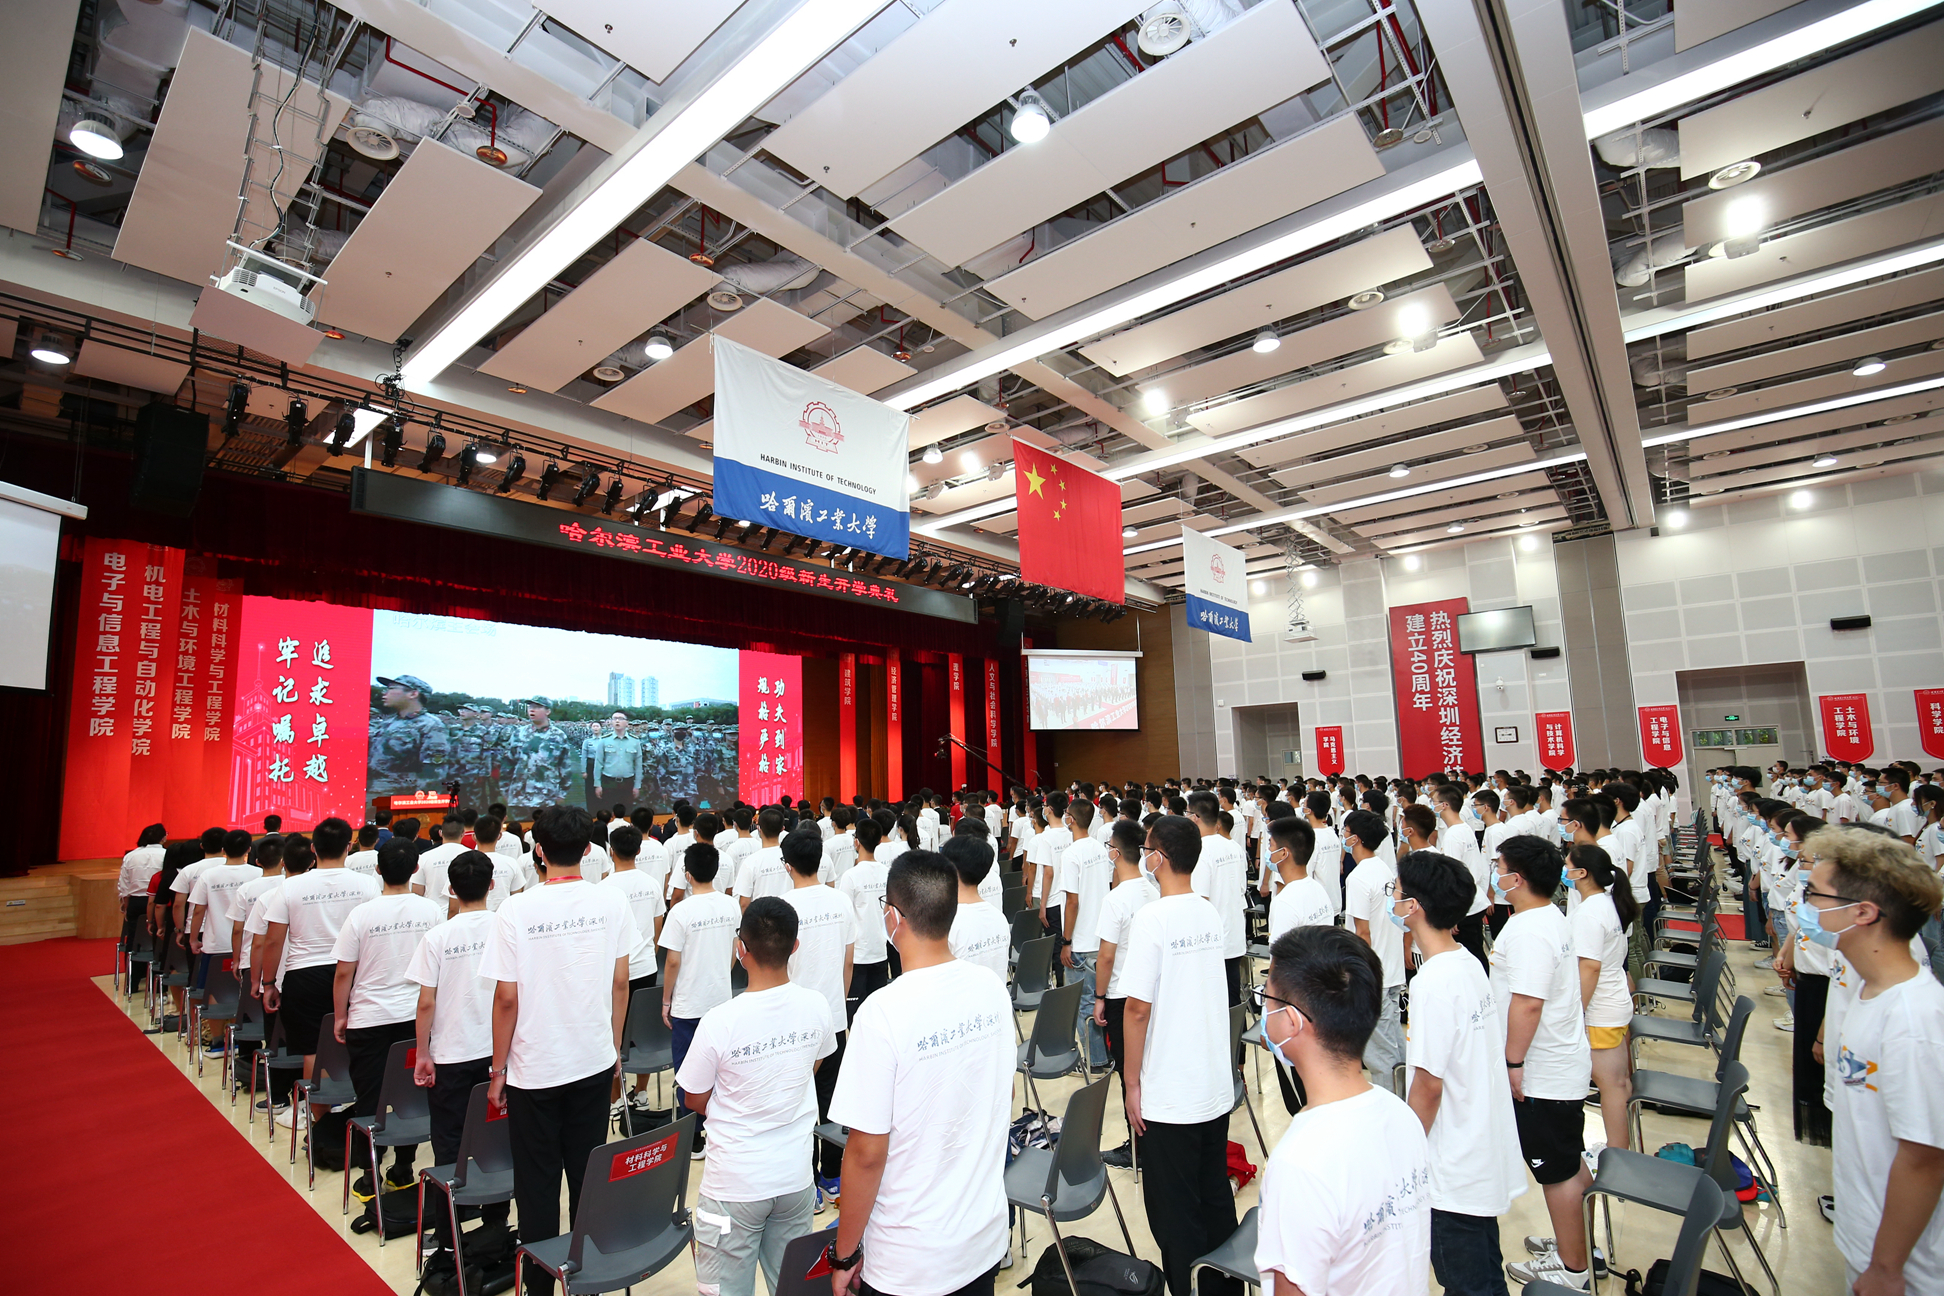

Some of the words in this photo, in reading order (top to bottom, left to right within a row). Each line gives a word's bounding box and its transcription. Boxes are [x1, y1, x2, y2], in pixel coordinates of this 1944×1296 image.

[760, 453, 787, 468] HARBIN
[790, 462, 823, 479] INSTITUTE
[826, 473, 834, 482] OF
[837, 477, 877, 495] TECHNOLOGY
[559, 521, 900, 603] 哈尔滨工业大学2020级新生开学典礼
[89, 552, 126, 737] 电子与信息工程学院
[131, 564, 166, 756] 机电工程与自动化学院
[171, 588, 201, 739] 土木与环境工程学院
[203, 602, 230, 742] 材料科学与工程学院
[1405, 613, 1433, 712] 建立40周年
[268, 636, 300, 784] 牢记嘱托
[302, 639, 334, 784] 追求卓越
[757, 676, 770, 774] 规格严格
[773, 678, 788, 776] 功夫到家
[1554, 723, 1565, 756] 计算机科学
[1650, 717, 1661, 744] 工程学院
[1660, 716, 1672, 751] 电子与信息
[1834, 707, 1847, 737] 工程学院
[1845, 706, 1860, 744] 土木与环境
[625, 1143, 668, 1165] 材料科学与
[628, 1153, 663, 1173] 工程学院
